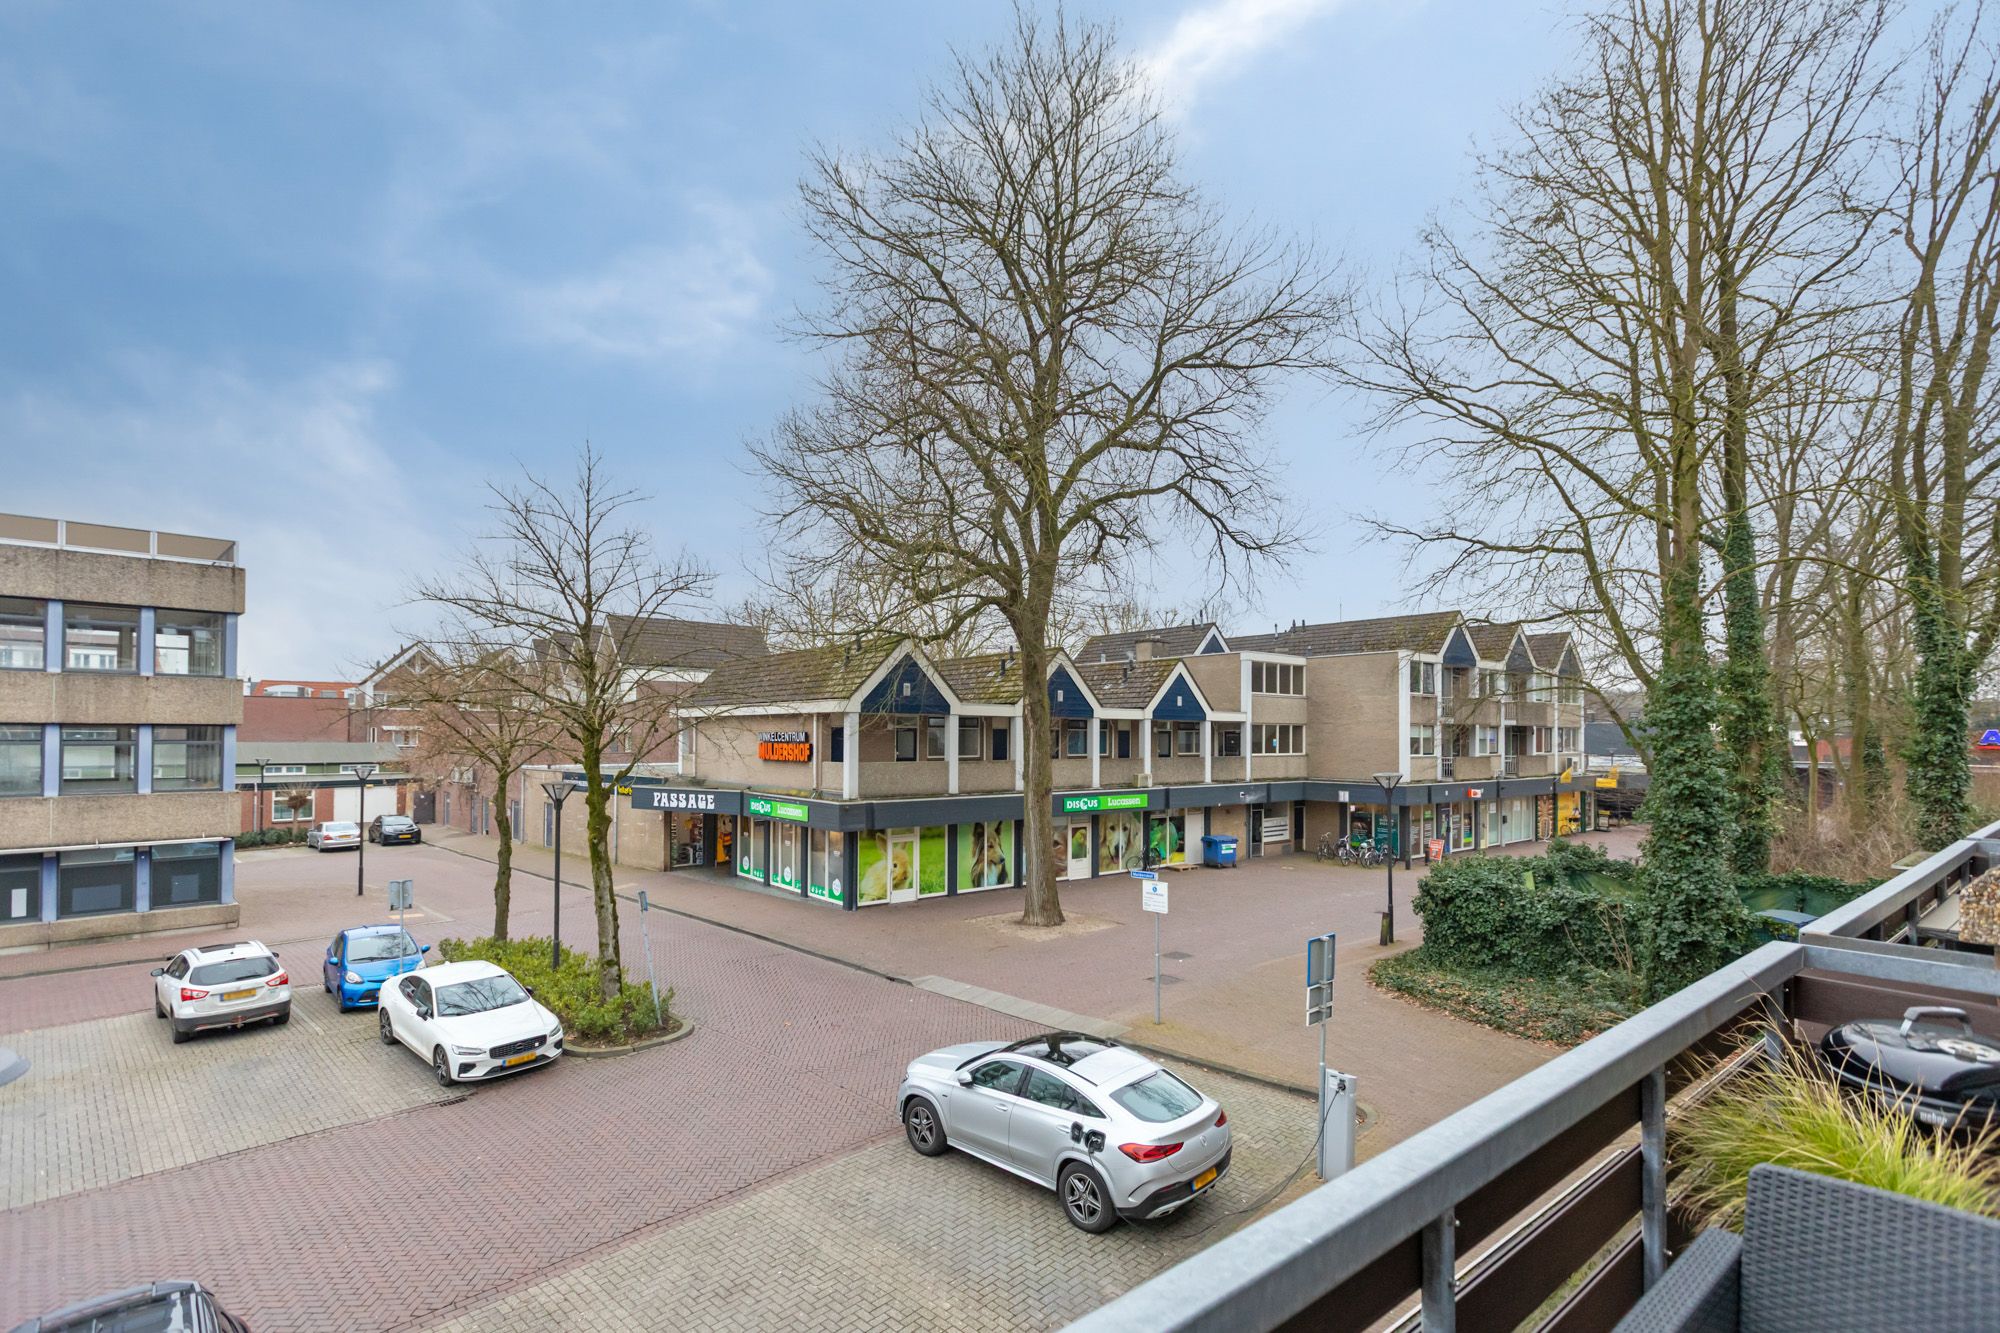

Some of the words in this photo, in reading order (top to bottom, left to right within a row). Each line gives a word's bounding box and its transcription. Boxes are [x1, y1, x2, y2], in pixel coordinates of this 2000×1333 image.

[758, 742, 810, 762] MULDERSHOF
[653, 792, 715, 810] PASSAGE
[1066, 798, 1098, 810] DISCUS
